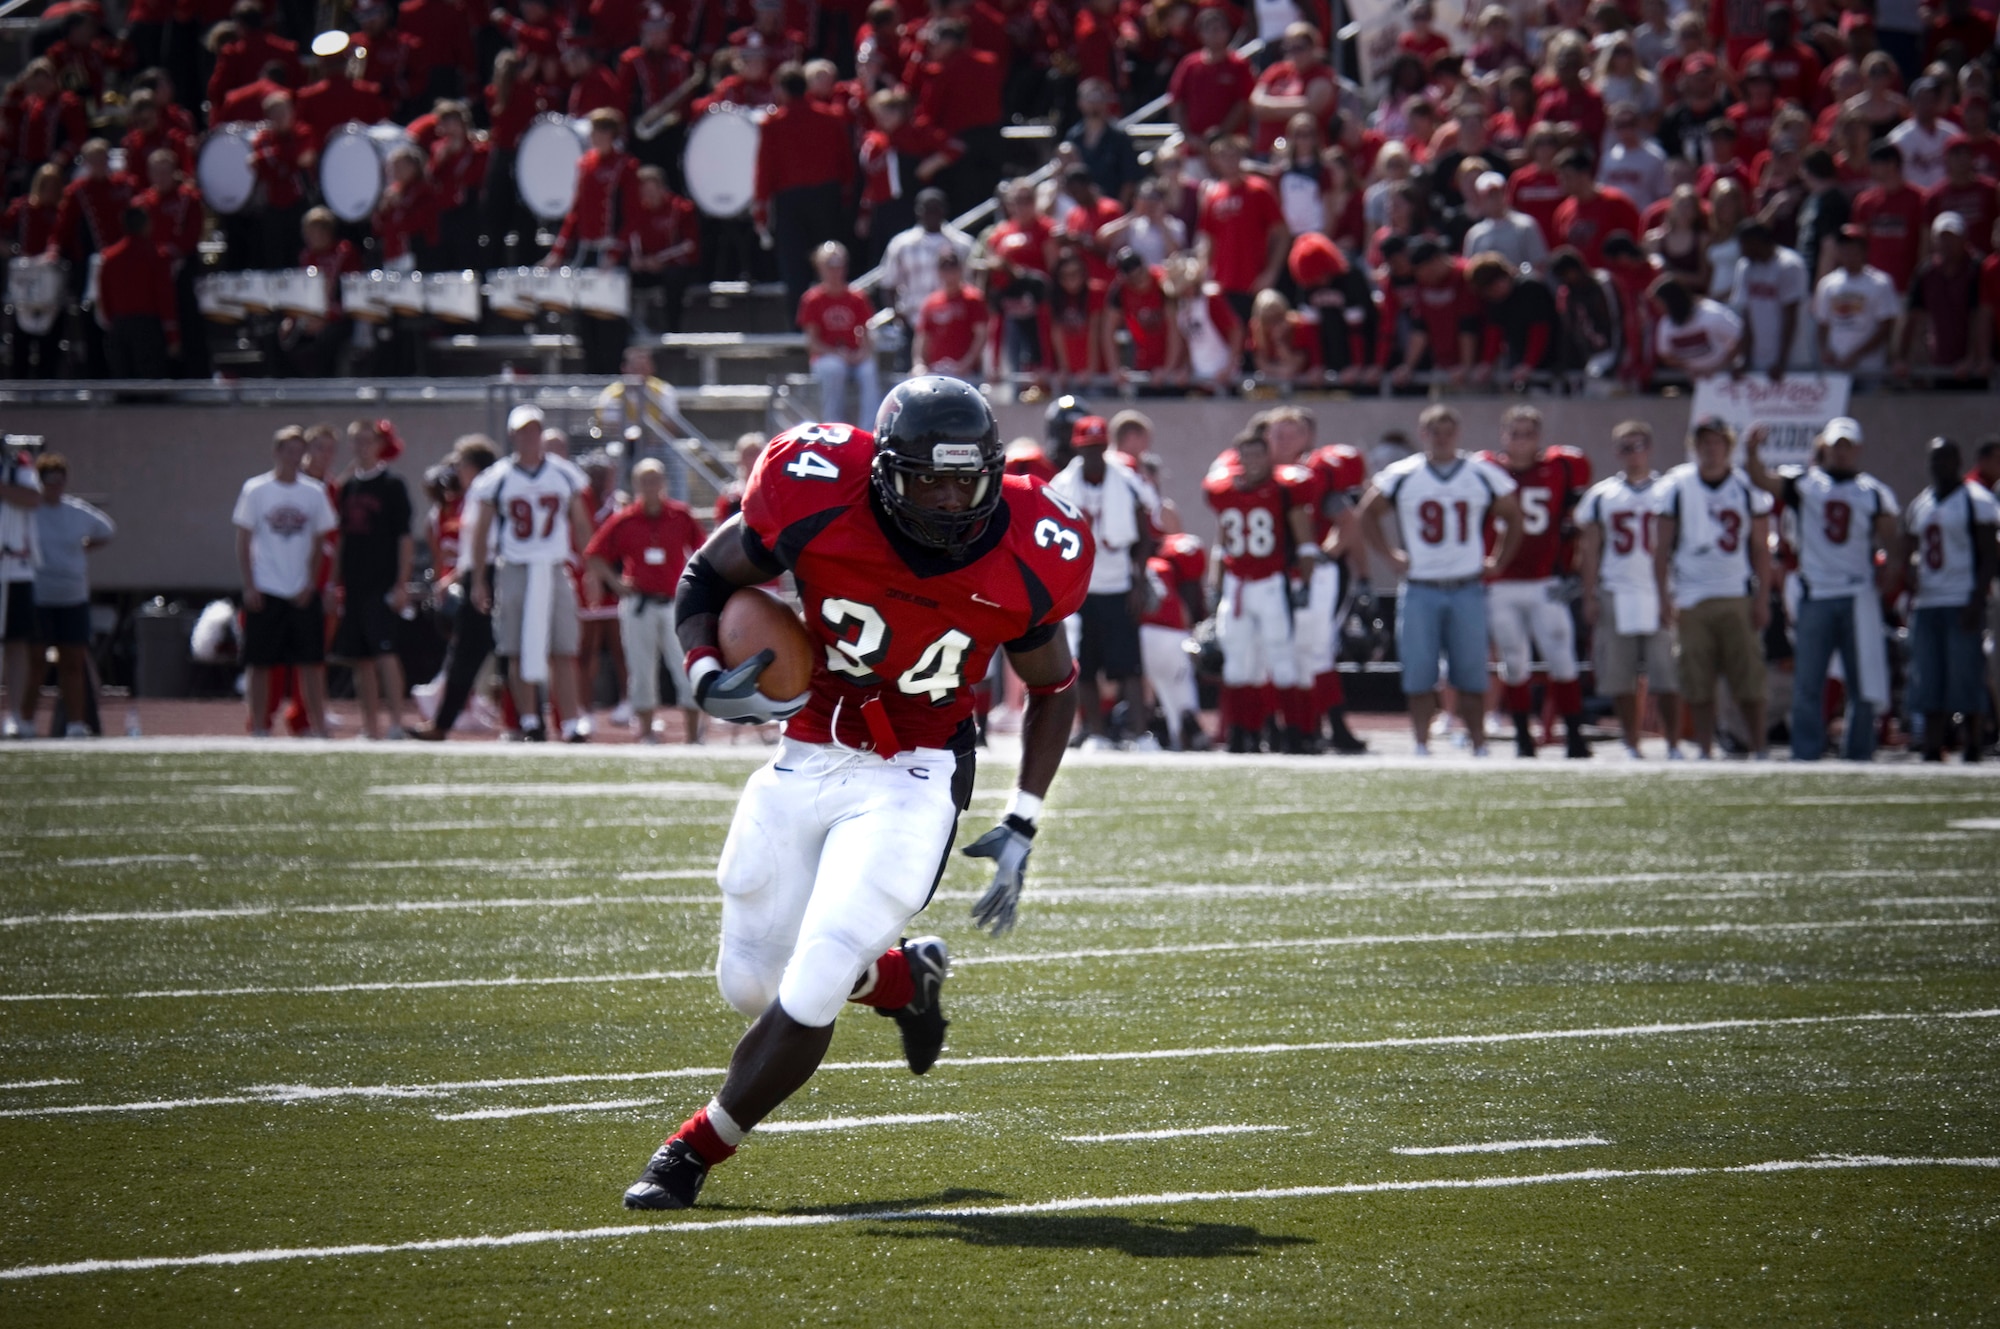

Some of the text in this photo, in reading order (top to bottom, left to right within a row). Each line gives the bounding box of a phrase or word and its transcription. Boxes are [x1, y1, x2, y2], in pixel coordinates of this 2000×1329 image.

[785, 422, 852, 482] 34
[509, 494, 559, 541] 97
[1033, 486, 1084, 562] 34
[1221, 507, 1275, 558] 38
[1418, 499, 1467, 544] 91
[1709, 508, 1741, 553] 3
[1824, 500, 1850, 544] 9
[1926, 523, 1944, 570] 8
[821, 597, 974, 706] 34
